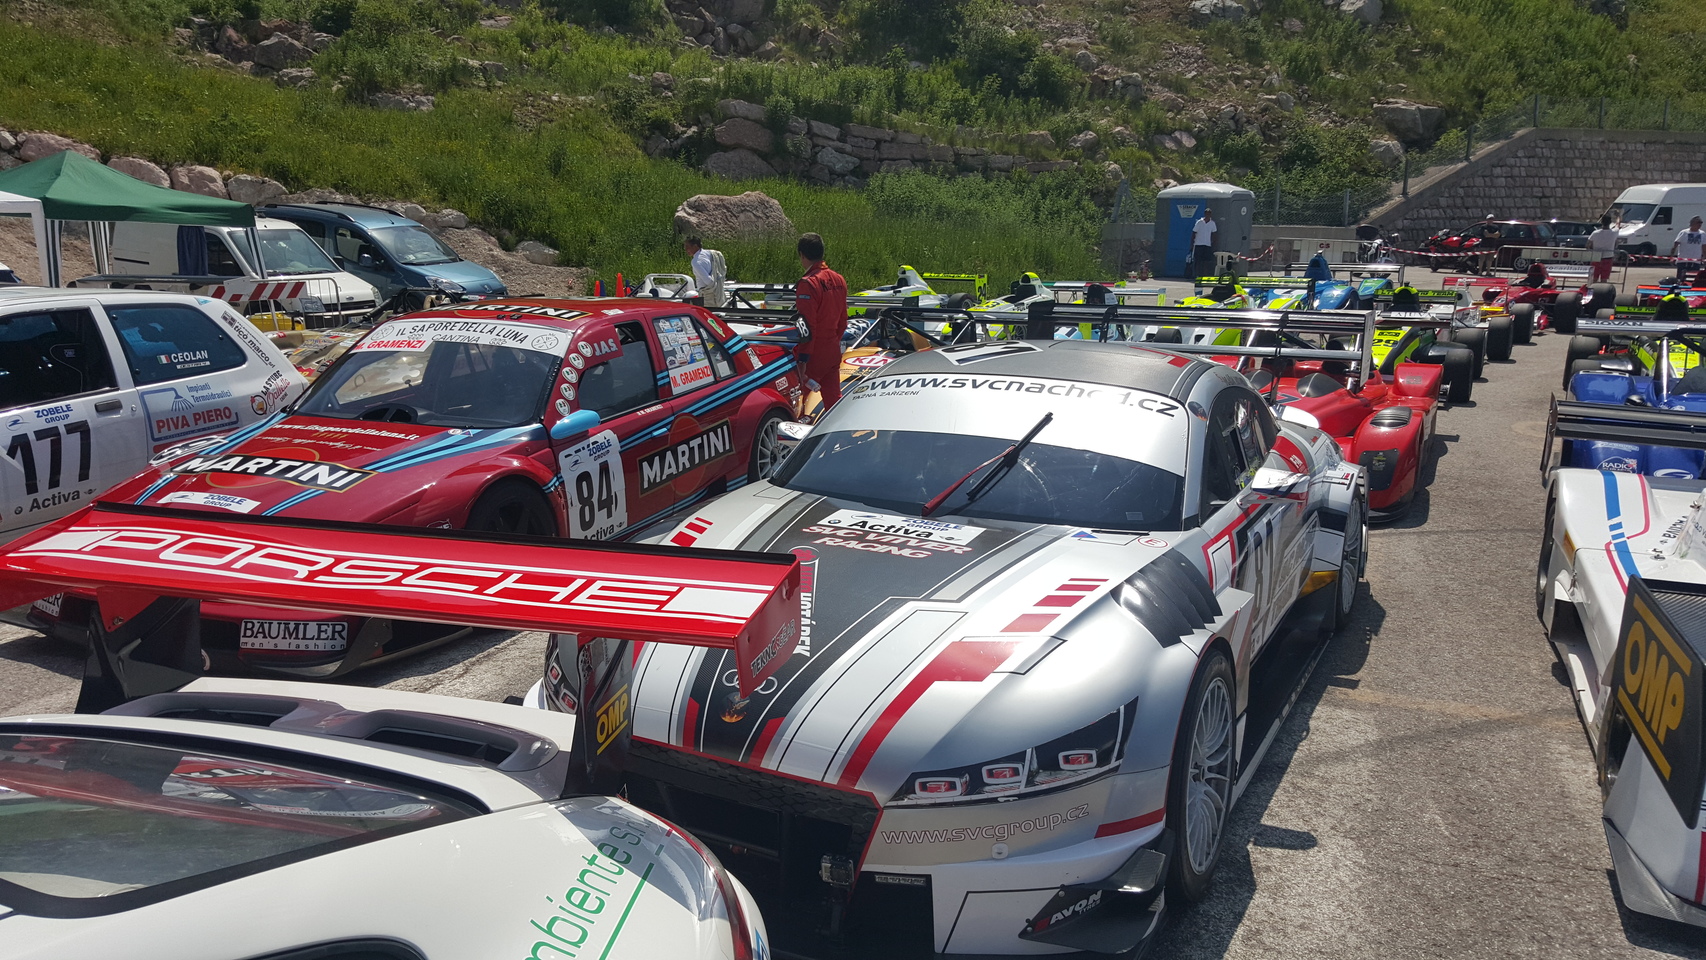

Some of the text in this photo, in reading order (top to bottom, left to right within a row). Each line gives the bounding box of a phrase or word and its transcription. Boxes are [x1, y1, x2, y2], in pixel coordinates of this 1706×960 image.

[412, 322, 459, 334] SAPORE
[459, 321, 499, 335] DELLA
[496, 327, 529, 344] LUNA
[796, 318, 809, 337] 18
[367, 339, 427, 349] GRAMENZI
[432, 333, 481, 343] CANTINA
[171, 350, 209, 363] CEOLAN
[852, 357, 889, 365] KIA
[679, 365, 713, 385] GRAMENZI
[186, 382, 211, 394] Impianti
[34, 404, 74, 418] ZOBELE
[45, 414, 70, 424] GROUP
[156, 415, 190, 433] PIVA
[192, 406, 232, 426] PIERO
[587, 438, 613, 457] ZOBELE
[593, 450, 610, 461] GROUP
[6, 420, 91, 495] 177
[641, 425, 730, 490] MARTINI
[173, 455, 363, 489] MARTINI
[28, 490, 81, 513] Activa
[202, 492, 244, 505] ZOBELE
[203, 500, 232, 508] GROUP
[575, 460, 615, 532] 84
[847, 520, 934, 539] Activa
[901, 517, 967, 531] ZOBELE
[906, 523, 949, 532] GROUP
[802, 526, 974, 554] SVC VITVER
[812, 537, 932, 559] RACING
[81, 531, 680, 610] PORSCHE
[241, 620, 346, 641] BÄUMLER
[240, 641, 346, 650] men's fashion
[1624, 621, 1685, 745] OMP
[596, 692, 628, 744] OMP
[881, 803, 1090, 845] www.svcgroup.cz
[1050, 889, 1103, 925] AVON
[1079, 898, 1101, 915] TYRES
